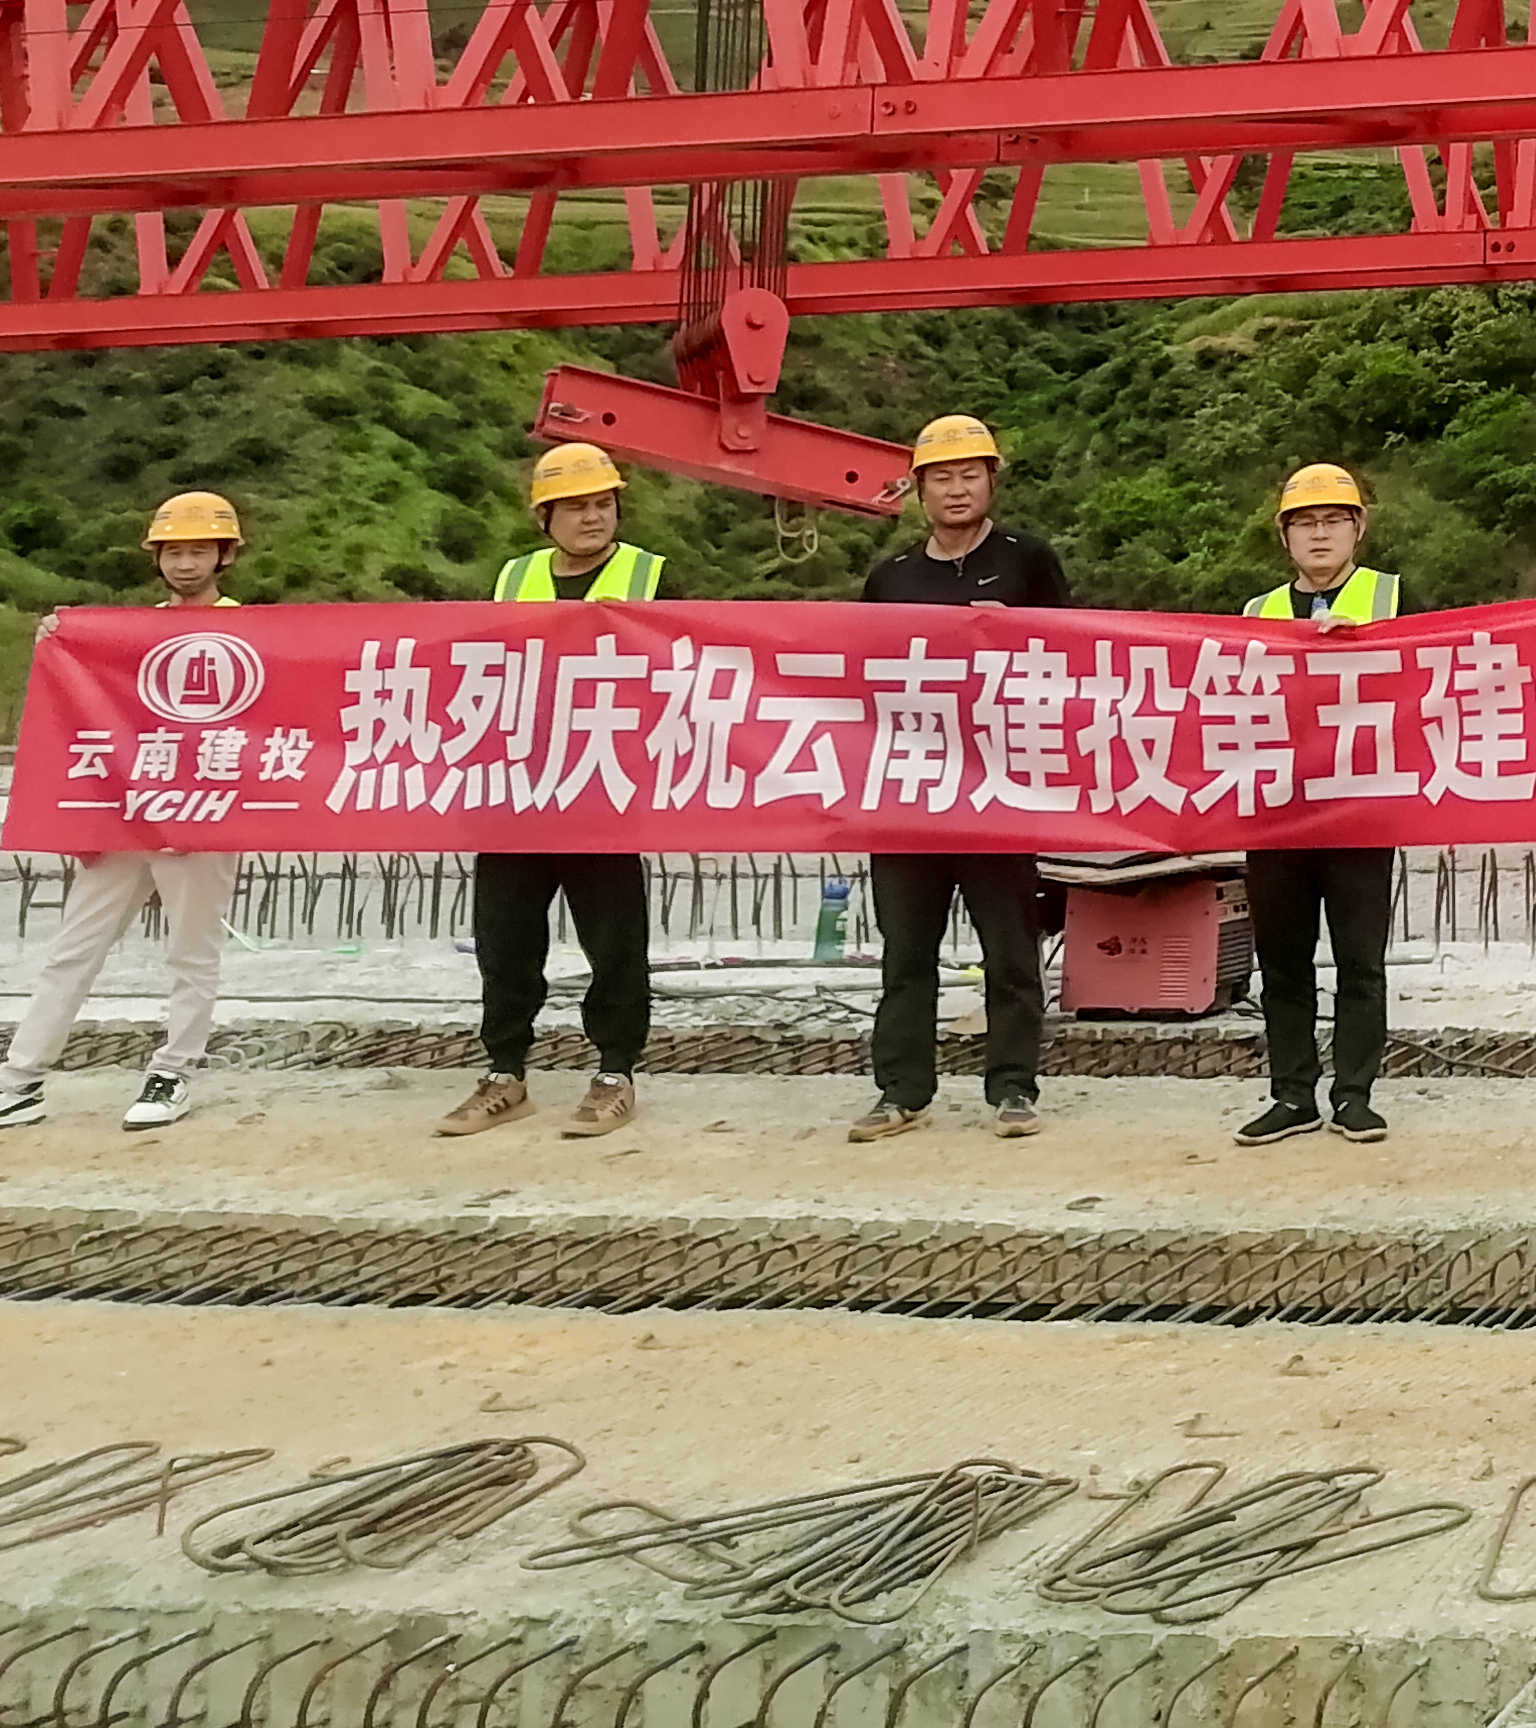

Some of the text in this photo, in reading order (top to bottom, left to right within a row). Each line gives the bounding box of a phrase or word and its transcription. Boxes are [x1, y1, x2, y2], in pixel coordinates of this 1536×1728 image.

[67, 727, 315, 782] 云南建投
[120, 789, 239, 822] YCIH
